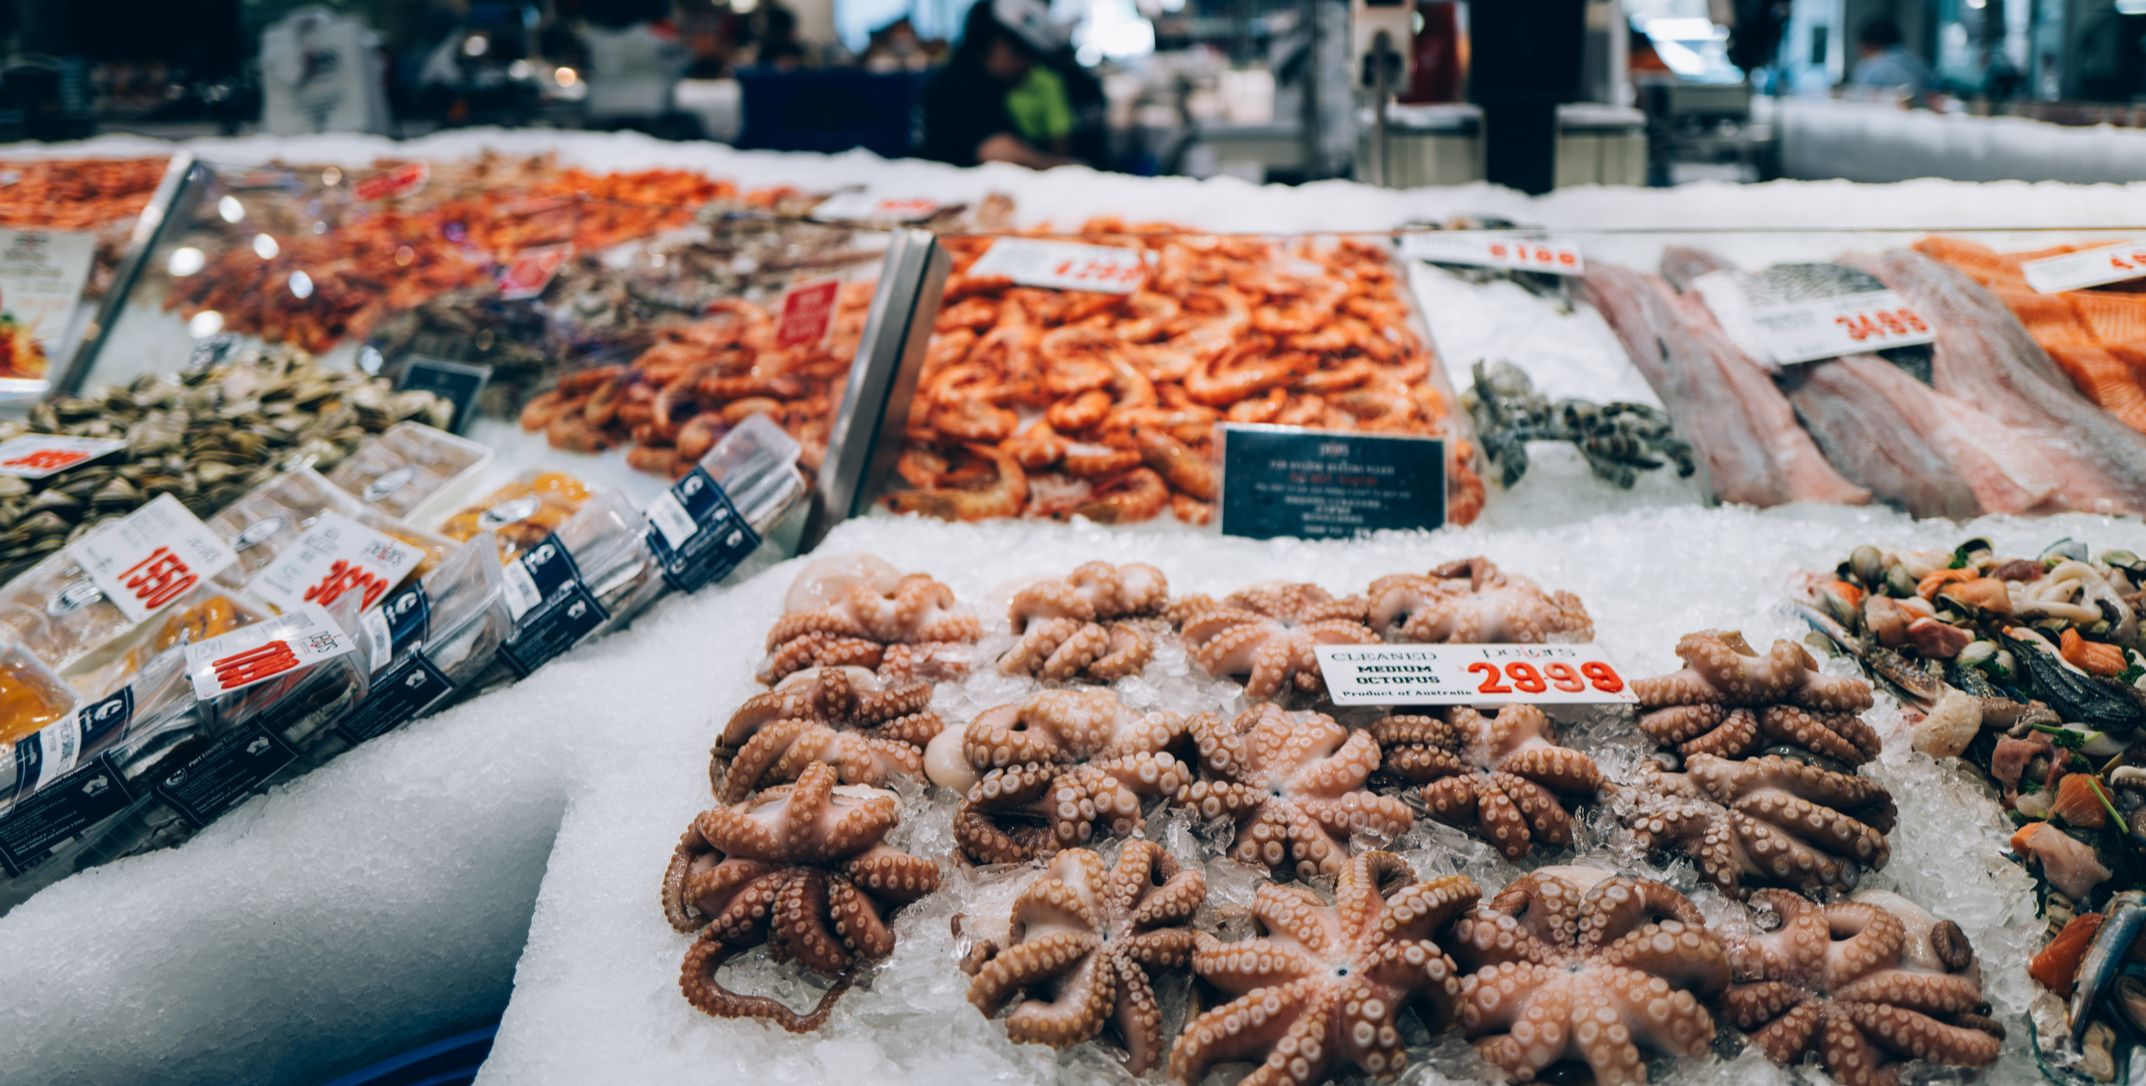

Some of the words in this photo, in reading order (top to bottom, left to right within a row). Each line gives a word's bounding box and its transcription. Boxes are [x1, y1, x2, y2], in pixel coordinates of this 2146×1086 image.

[1835, 308, 1928, 341] 3499
[117, 545, 200, 609] 1550
[1330, 652, 1438, 661] CLEANED
[1356, 665, 1433, 673] MEDIUM
[1355, 676, 1442, 685] OCTOPUS
